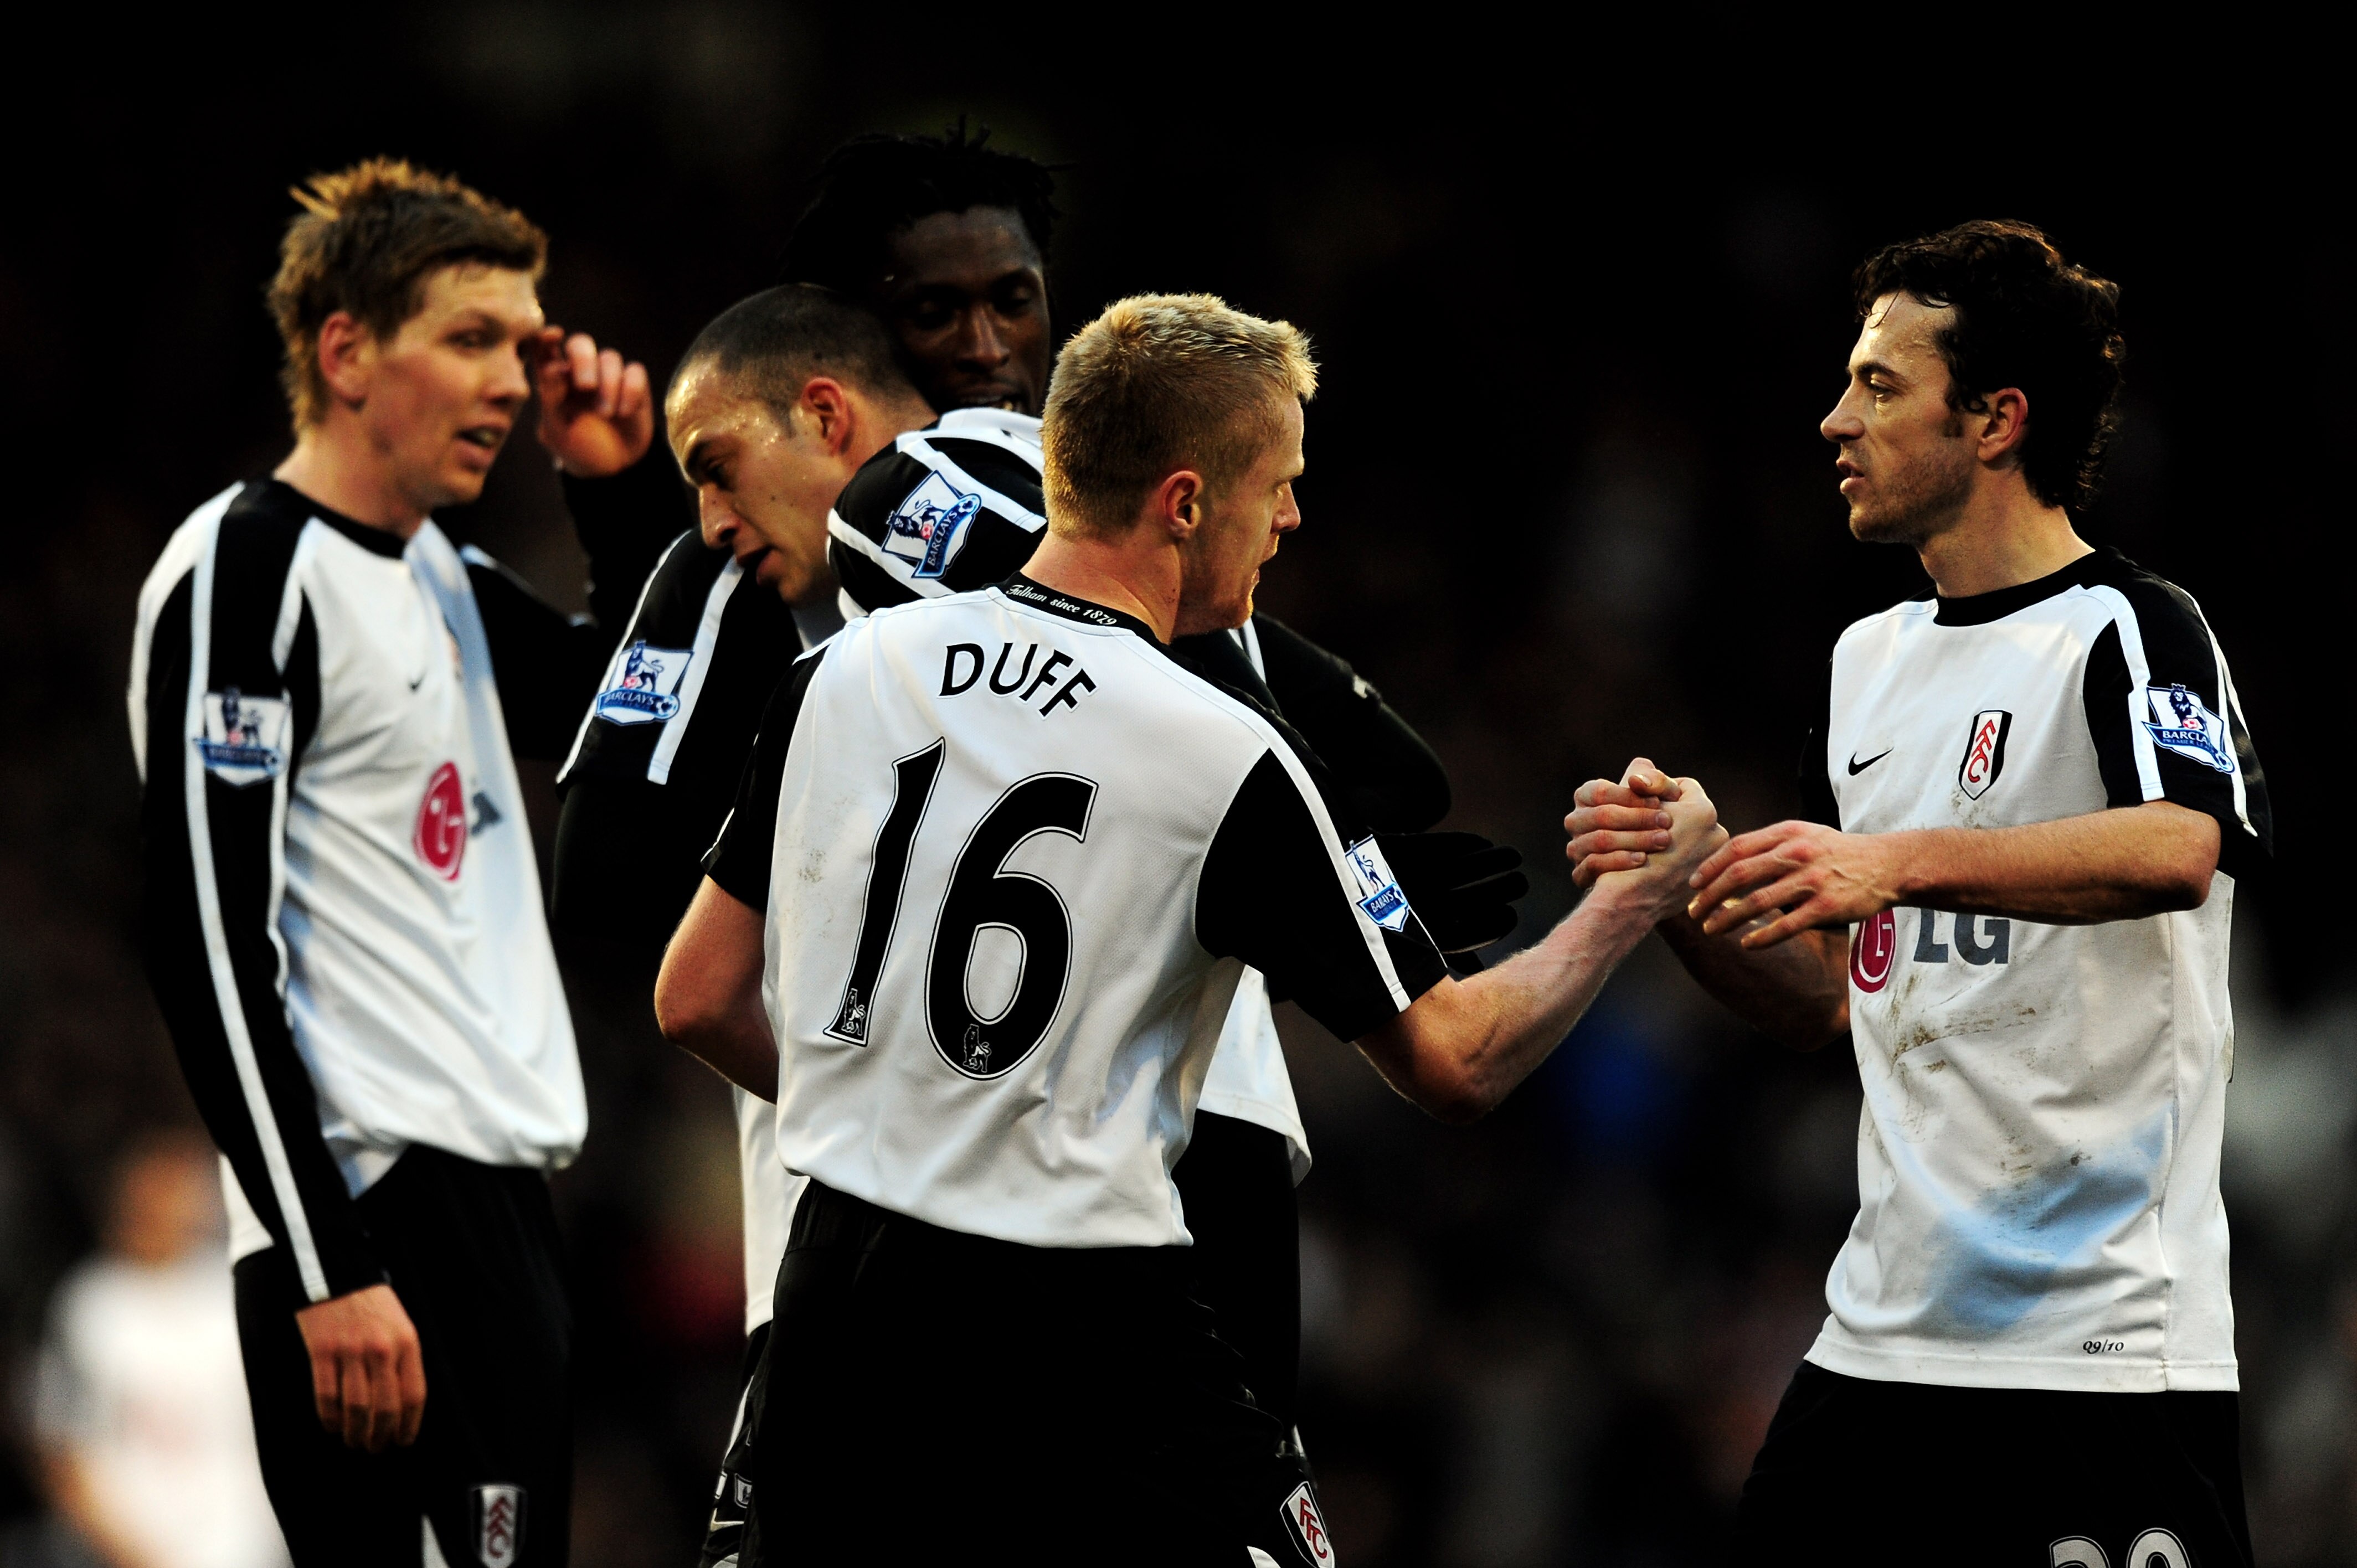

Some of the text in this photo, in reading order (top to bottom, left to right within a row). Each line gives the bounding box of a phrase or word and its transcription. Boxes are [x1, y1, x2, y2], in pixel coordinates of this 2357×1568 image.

[928, 511, 957, 566] BARCLAYS
[1006, 584, 1117, 625] Fulham since 1879
[939, 643, 1096, 716] DUFF
[1968, 719, 1996, 783] FFC
[2163, 730, 2210, 745] BARCLA
[823, 737, 1099, 1080] 16
[1913, 908, 2010, 966] LG
[1299, 1497, 1327, 1559] FFC
